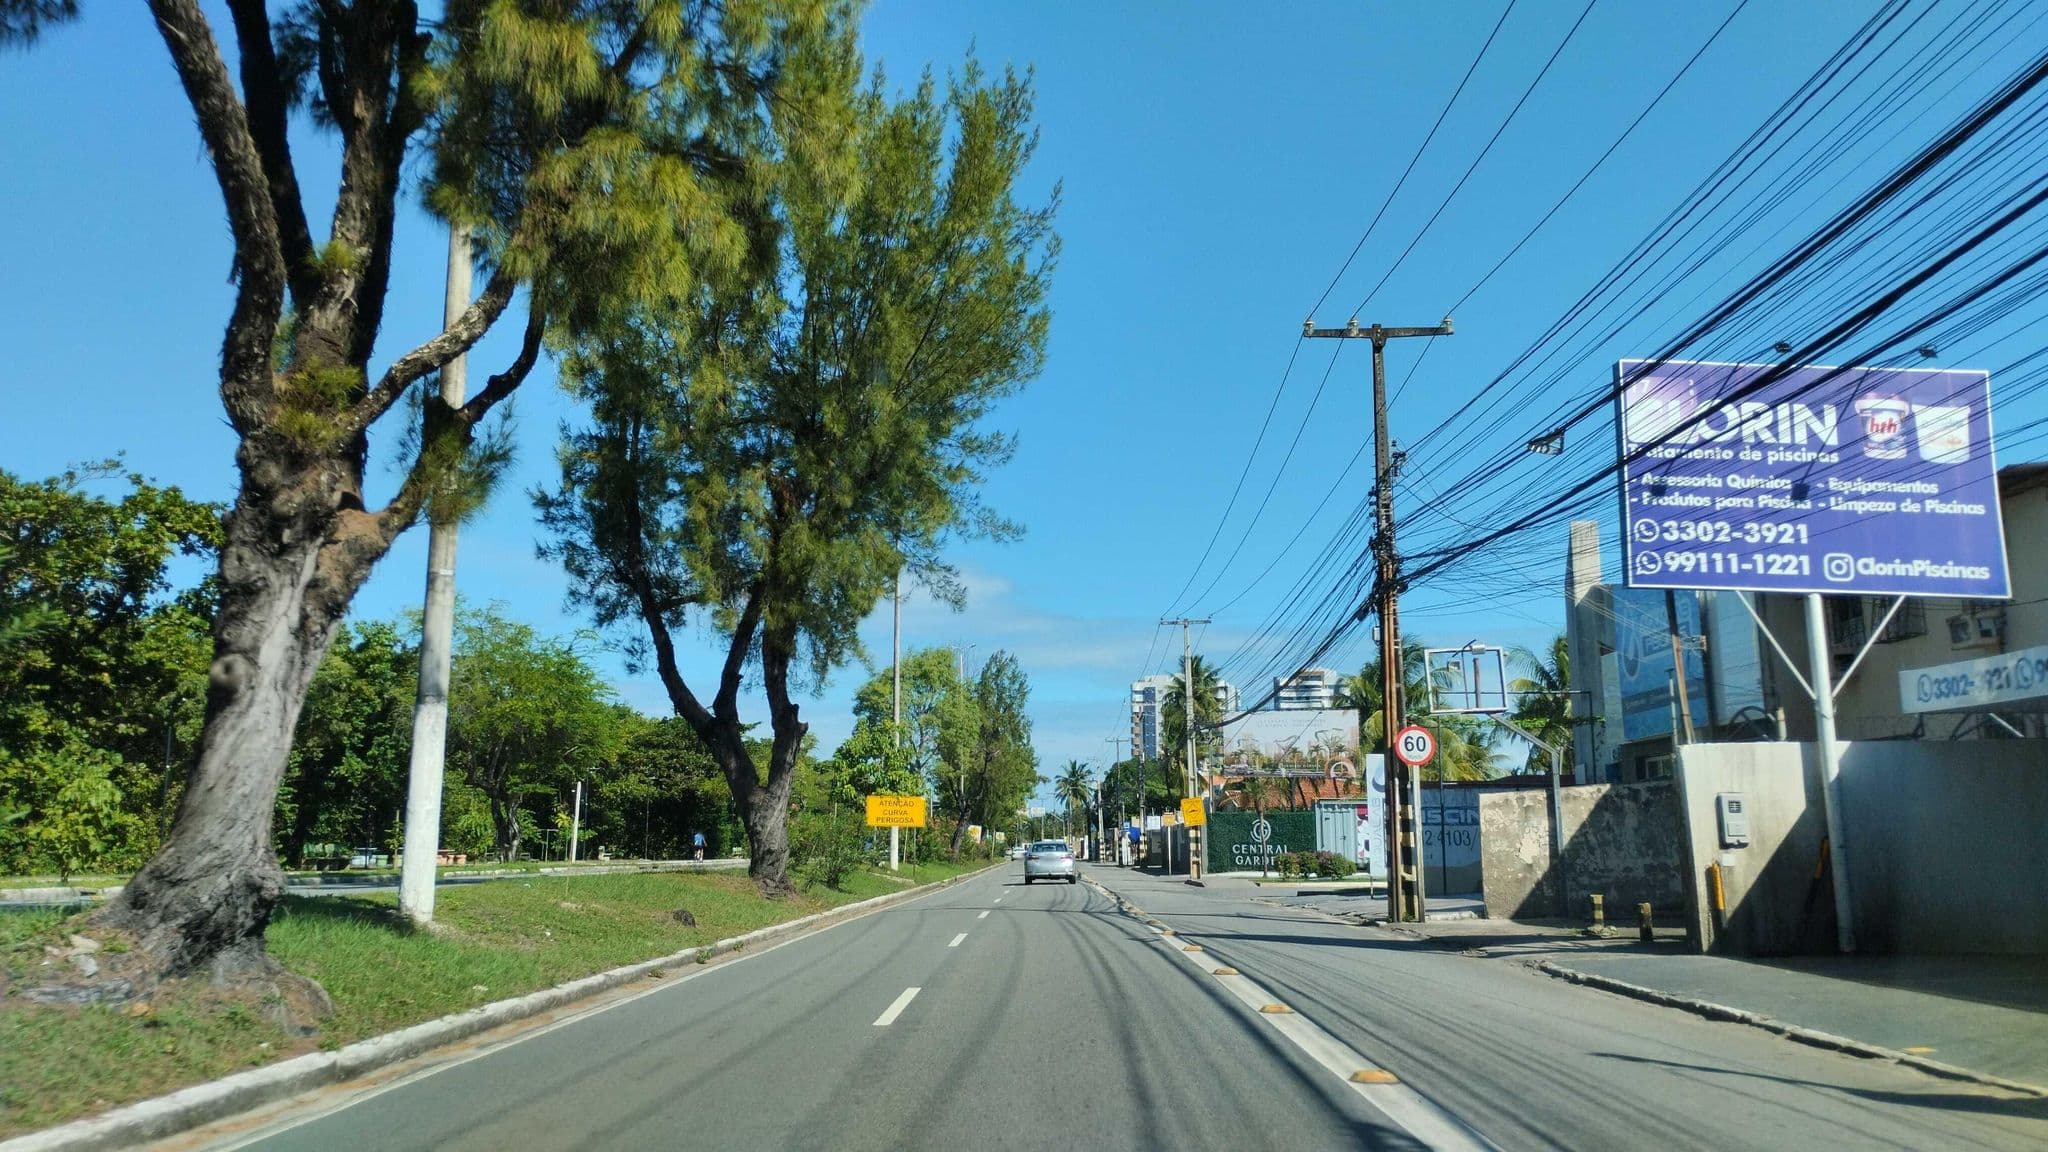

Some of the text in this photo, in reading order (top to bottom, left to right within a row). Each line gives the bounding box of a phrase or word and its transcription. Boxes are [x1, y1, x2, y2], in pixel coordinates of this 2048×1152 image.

[1740, 446, 1761, 461] de
[1767, 447, 1840, 465] piscinas
[1828, 476, 1939, 495] Equipamentos
[1642, 491, 1712, 507] Produtos
[1715, 496, 1754, 510] para
[1830, 497, 1986, 515] Limpeza de Piscinas
[1662, 520, 1809, 545] 3302-3921
[1663, 551, 1811, 576] 99111-1221
[1855, 556, 1991, 580] ClorinPiscinas
[1404, 735, 1427, 752] 60
[876, 816, 915, 824] PERIGOSA
[1232, 844, 1288, 854] CENTRAL
[1235, 855, 1276, 866] GARDE
